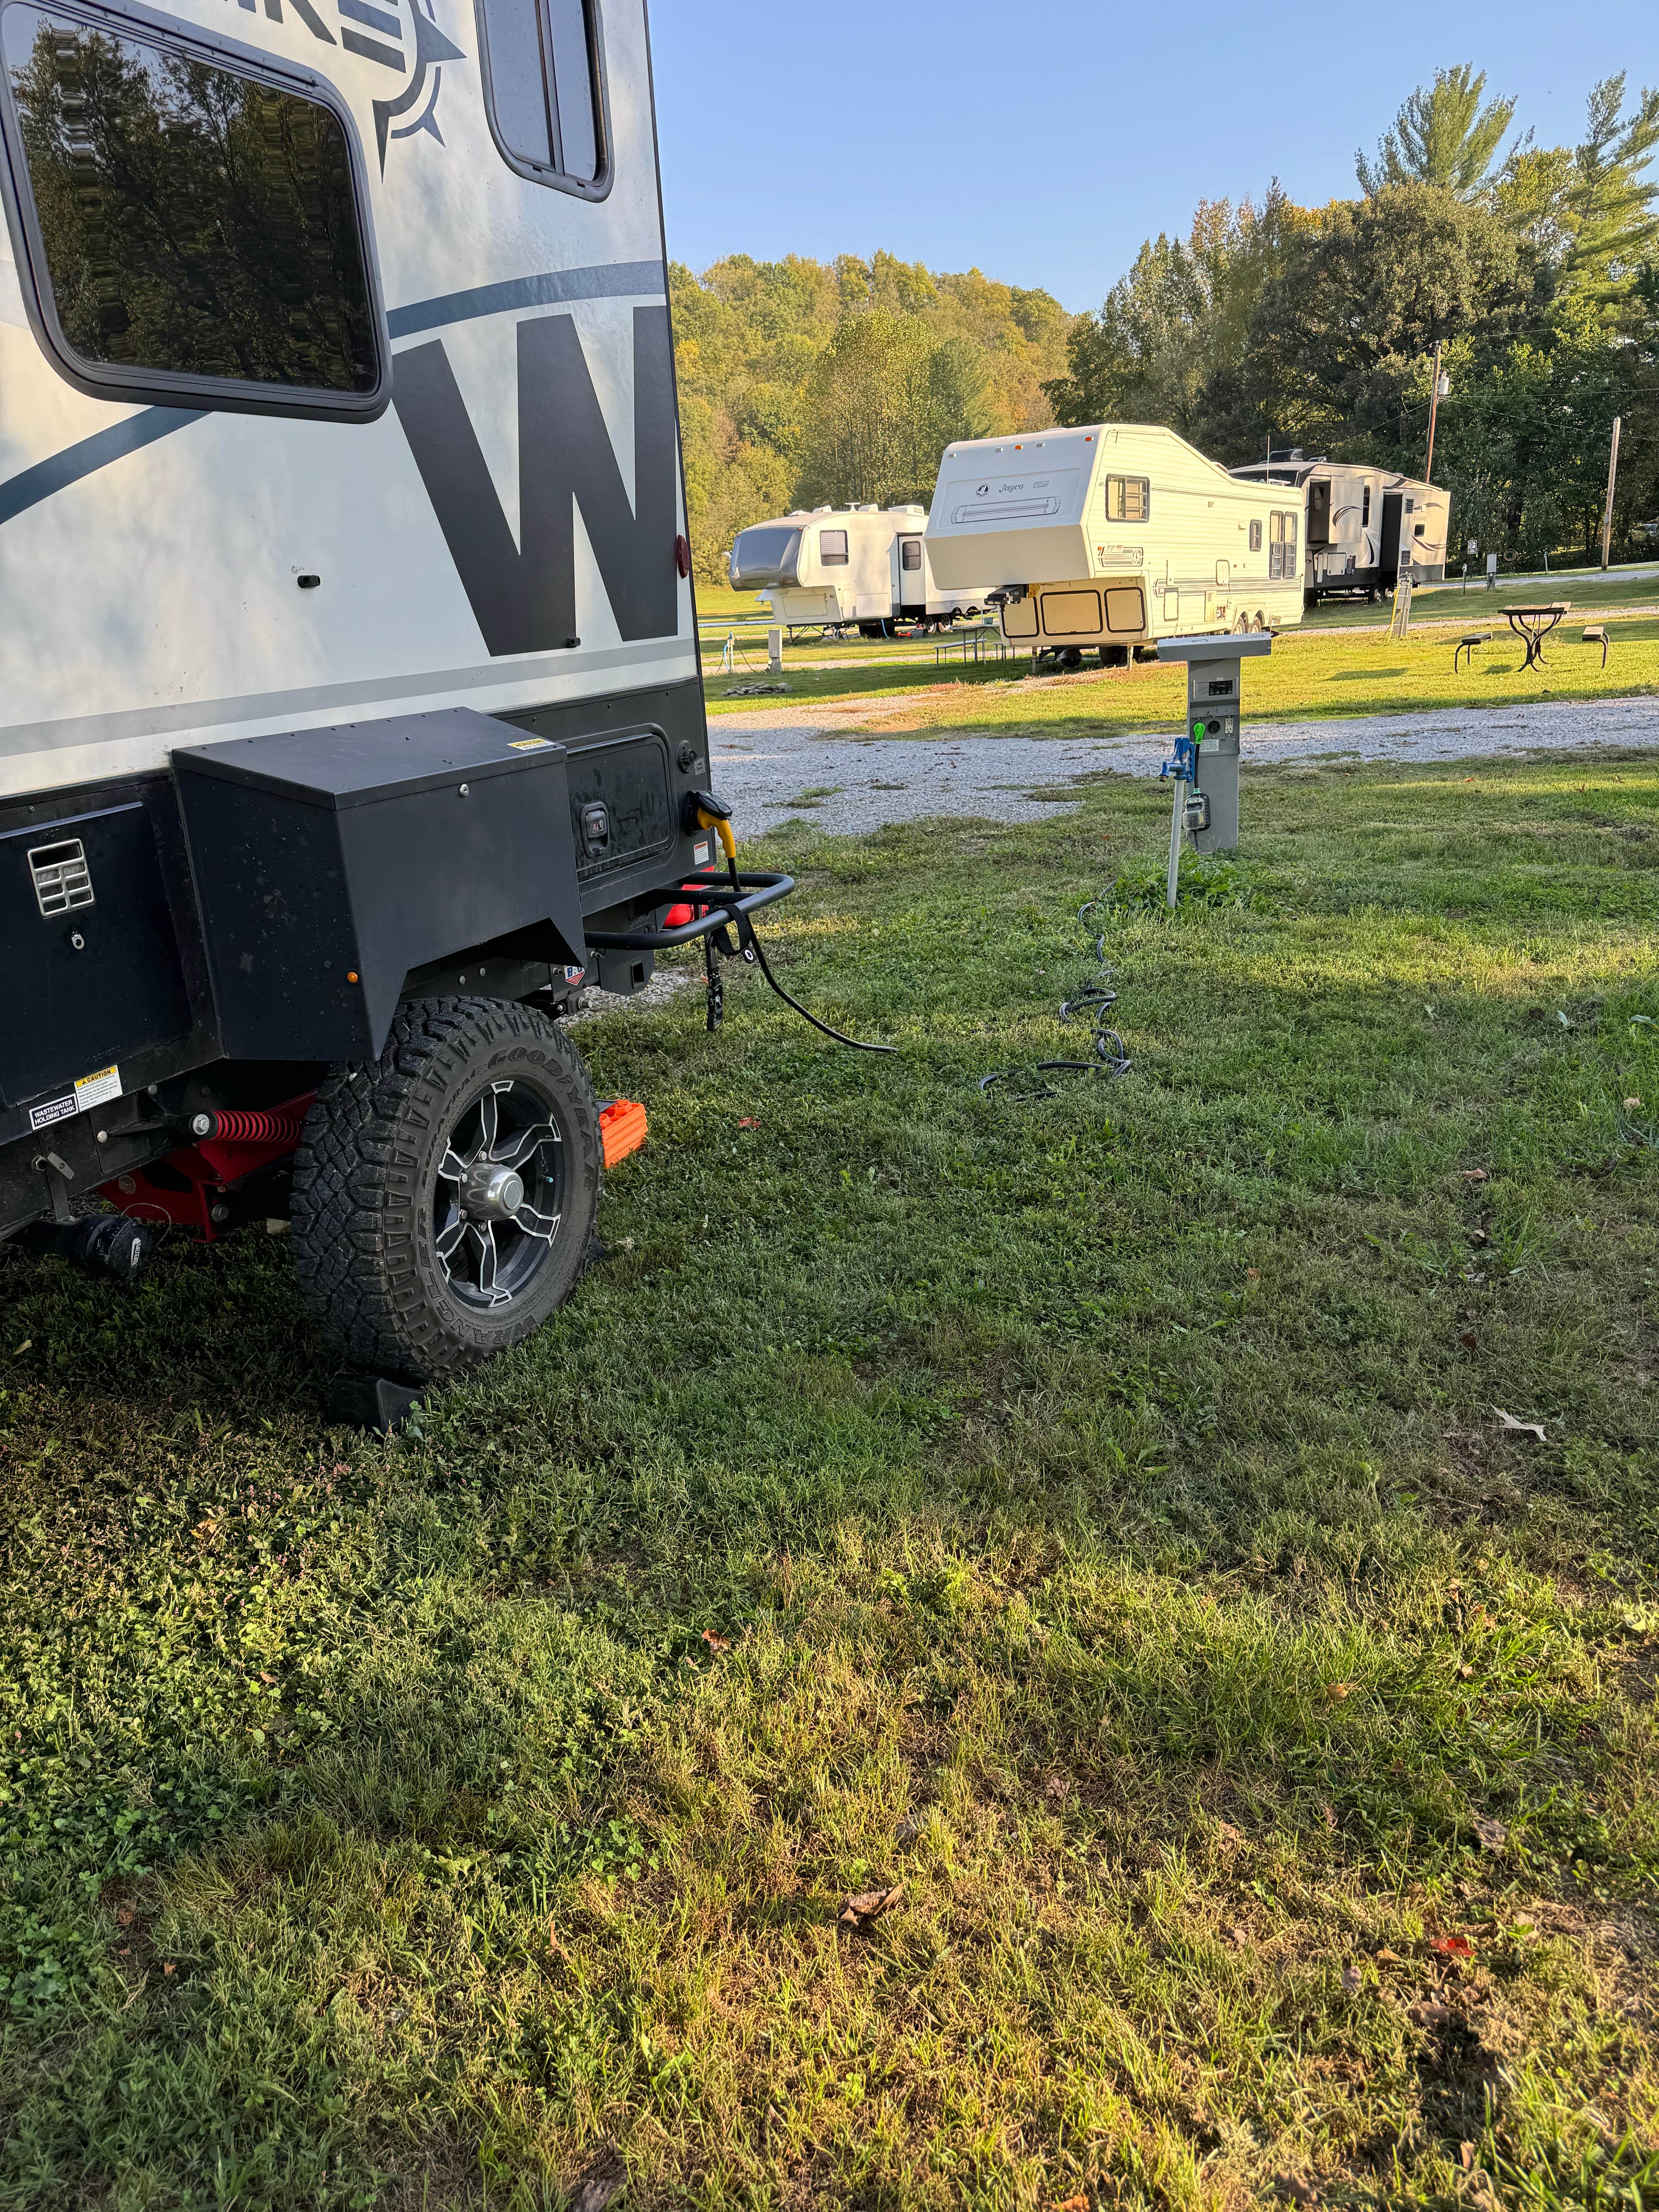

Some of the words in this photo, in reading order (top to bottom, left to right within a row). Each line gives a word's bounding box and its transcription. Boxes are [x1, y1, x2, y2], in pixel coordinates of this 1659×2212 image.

[390, 306, 678, 657] W
[999, 484, 1024, 493] Jayco
[87, 1069, 111, 1082] CAUTION
[34, 1099, 73, 1118] WASTEWATER
[34, 1111, 60, 1125] HOLDING
[60, 1105, 75, 1115] TANK
[488, 1047, 594, 1190] GOODYEAR
[417, 1207, 538, 1344] WRANGLER
